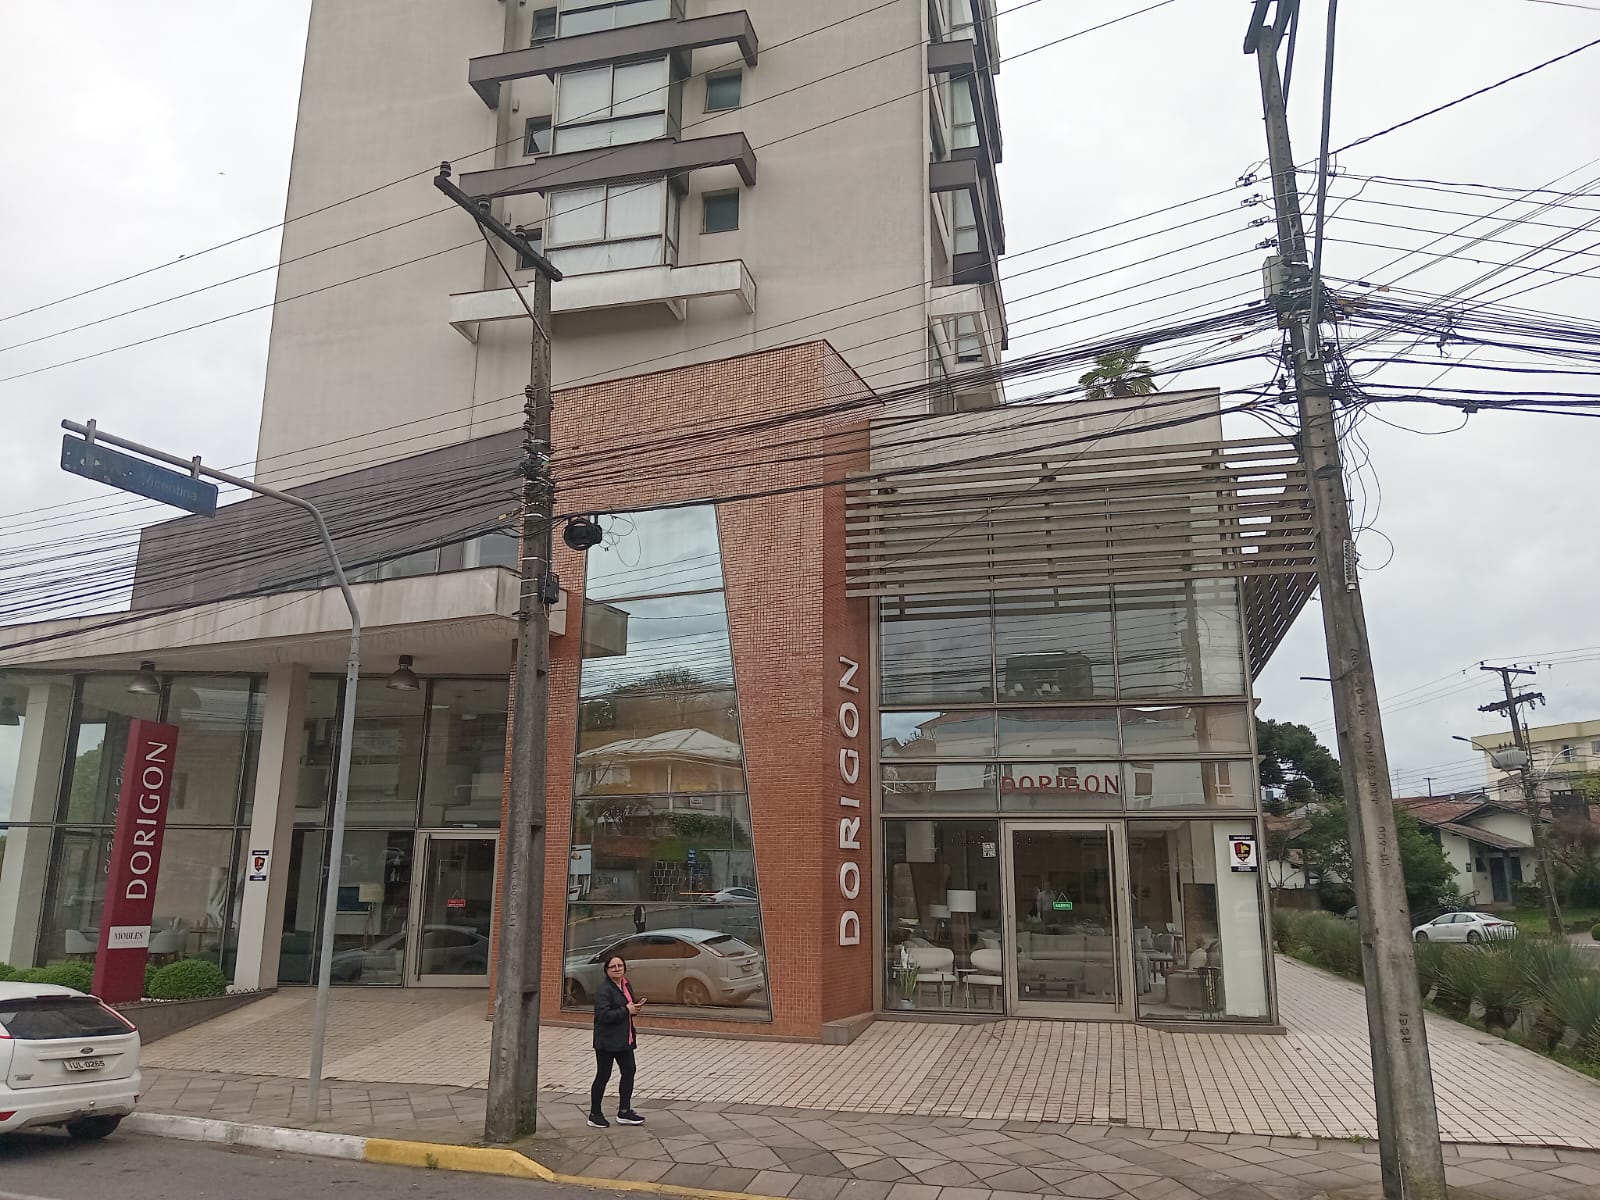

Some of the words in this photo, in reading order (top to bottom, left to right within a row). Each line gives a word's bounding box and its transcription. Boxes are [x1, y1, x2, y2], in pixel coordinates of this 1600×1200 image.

[126, 741, 168, 899] DORIGON
[839, 656, 861, 946] DORIGON
[1001, 774, 1120, 795] DORIGON
